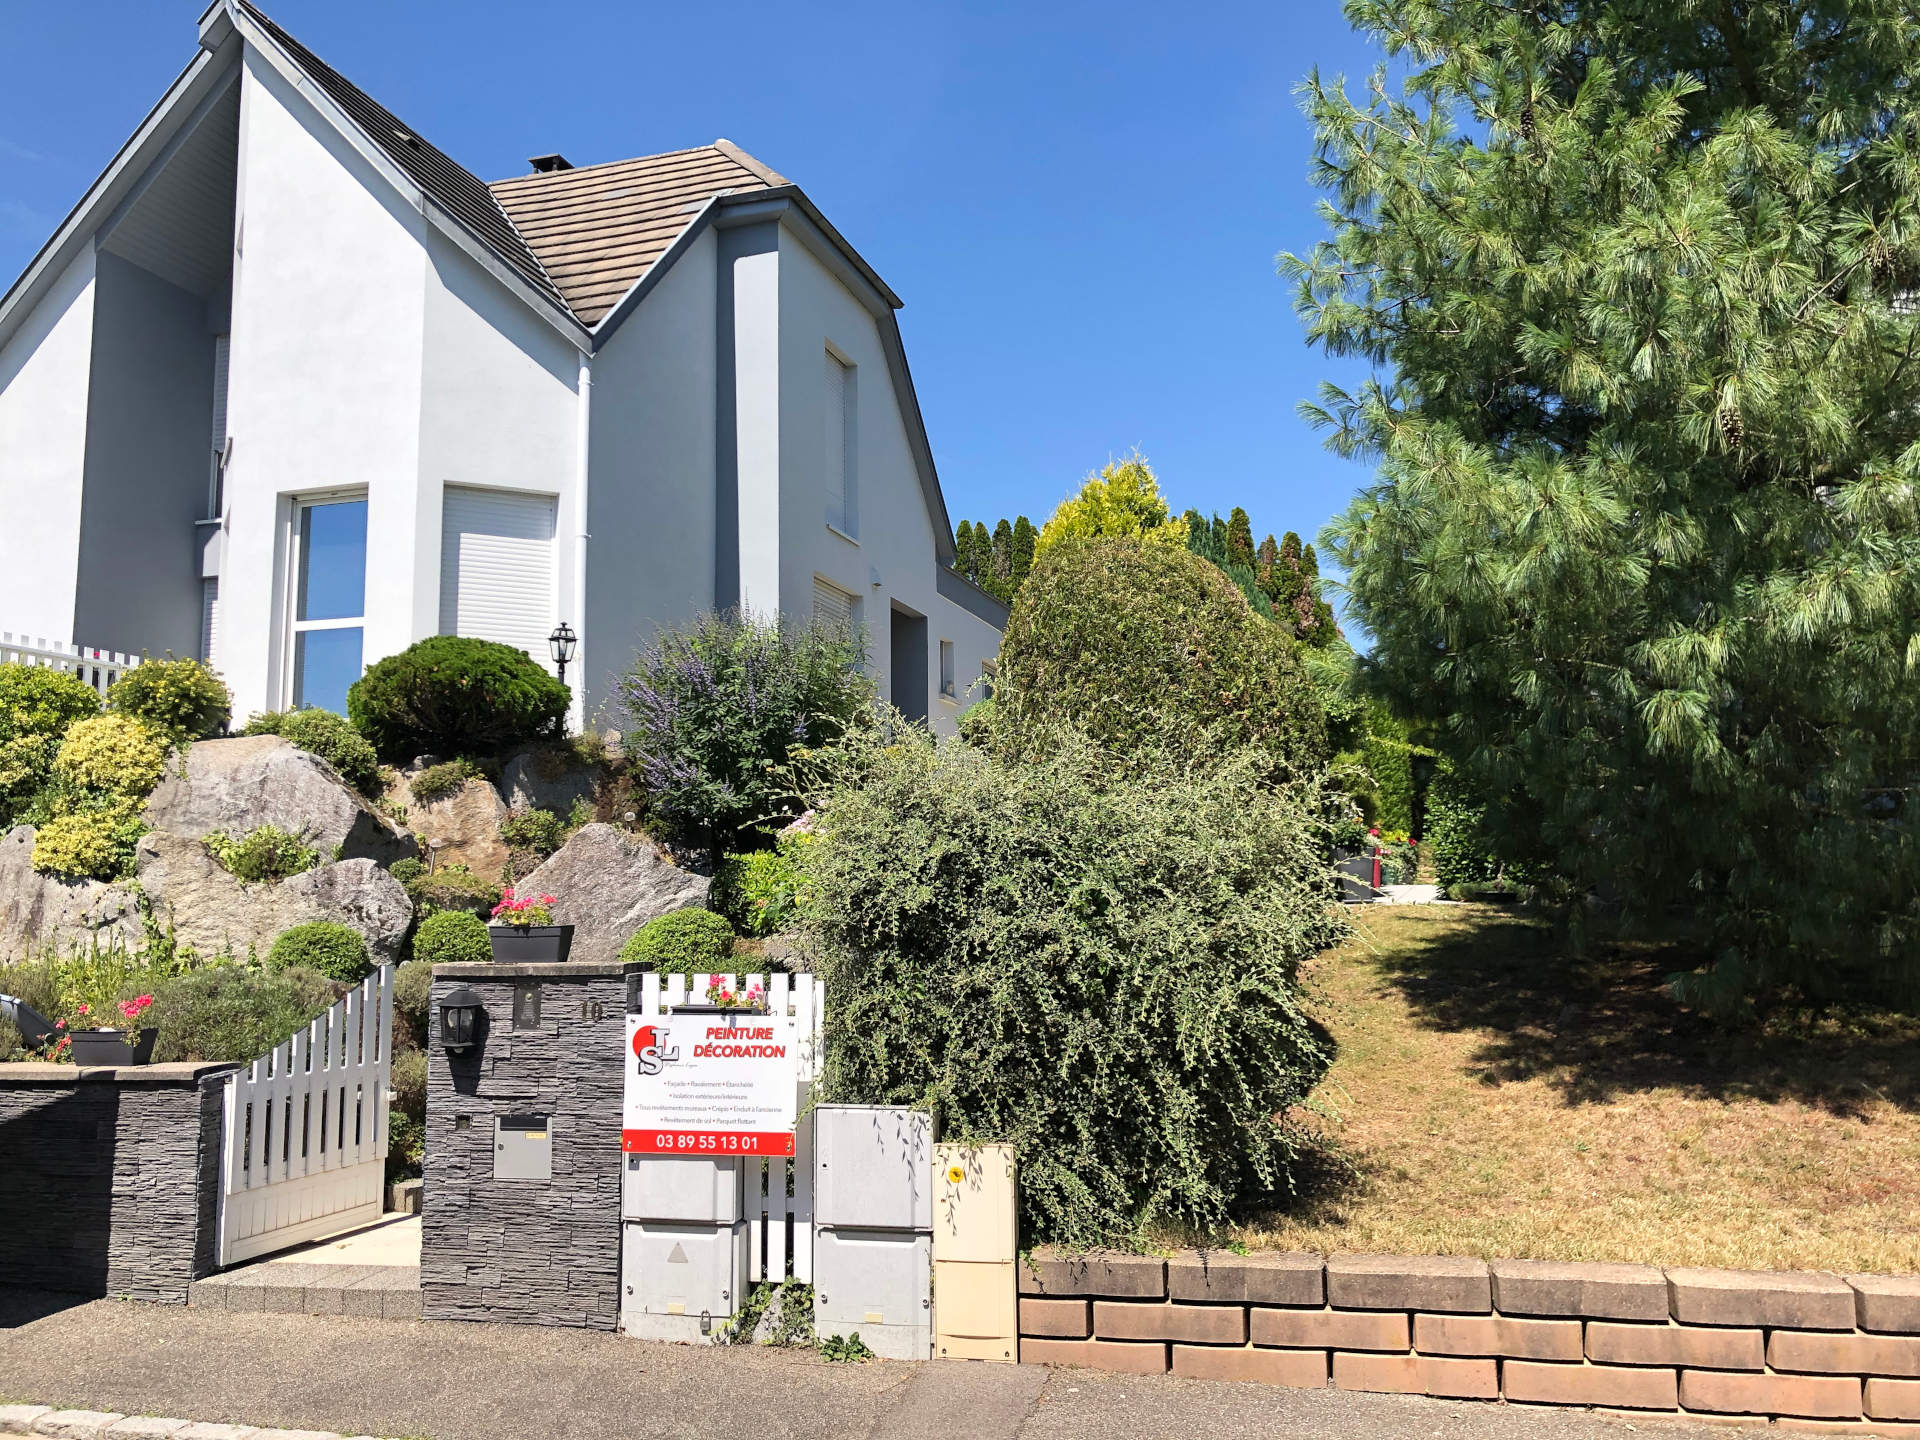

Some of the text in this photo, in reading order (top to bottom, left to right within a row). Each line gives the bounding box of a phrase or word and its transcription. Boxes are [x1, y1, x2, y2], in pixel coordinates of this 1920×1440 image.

[582, 1001, 602, 1022] 10
[706, 1027, 774, 1040] PEINTURE
[693, 1042, 786, 1058] DÉCORATION
[667, 1080, 686, 1088] Façade
[726, 1080, 754, 1088] Étanchéité
[716, 1118, 737, 1126] Parquet
[656, 1134, 758, 1150] 03 89 55 13 01
